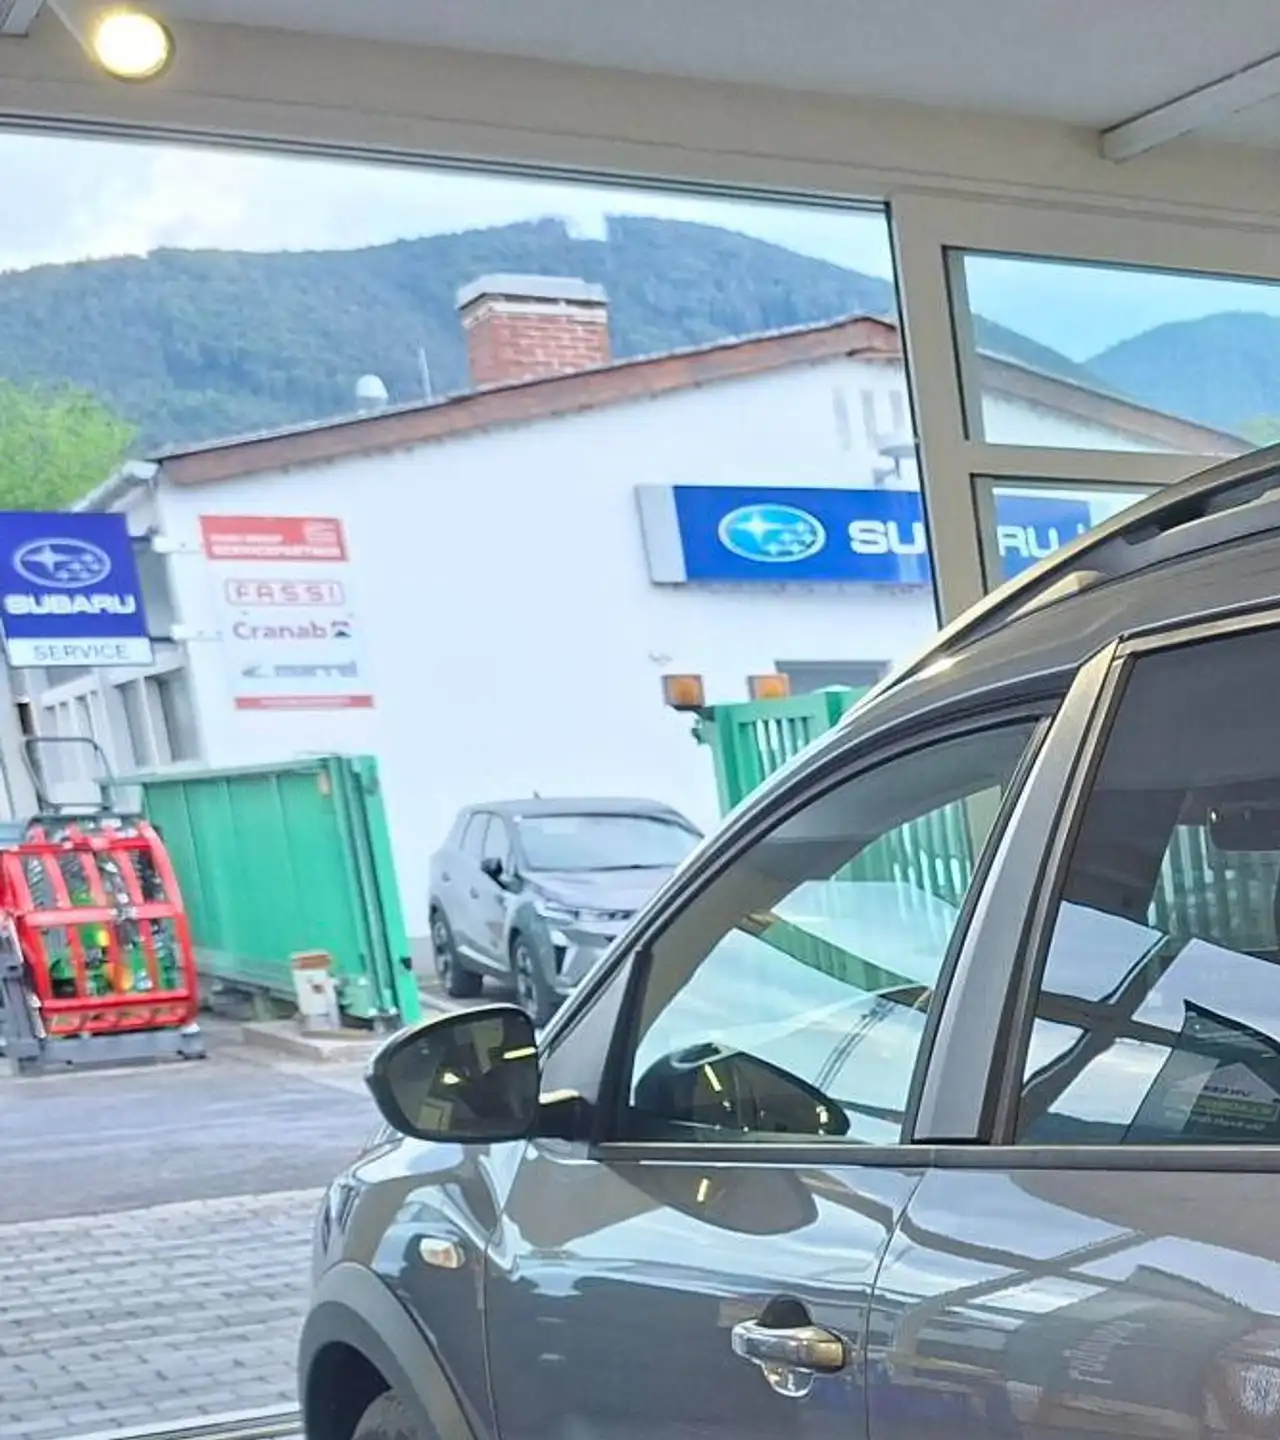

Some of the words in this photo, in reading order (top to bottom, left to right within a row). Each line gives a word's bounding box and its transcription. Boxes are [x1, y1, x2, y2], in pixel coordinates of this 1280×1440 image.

[848, 519, 1060, 558] SURU
[4, 593, 136, 614] SUBARU
[232, 620, 328, 640] Cranab
[33, 643, 129, 661] SERVICE
